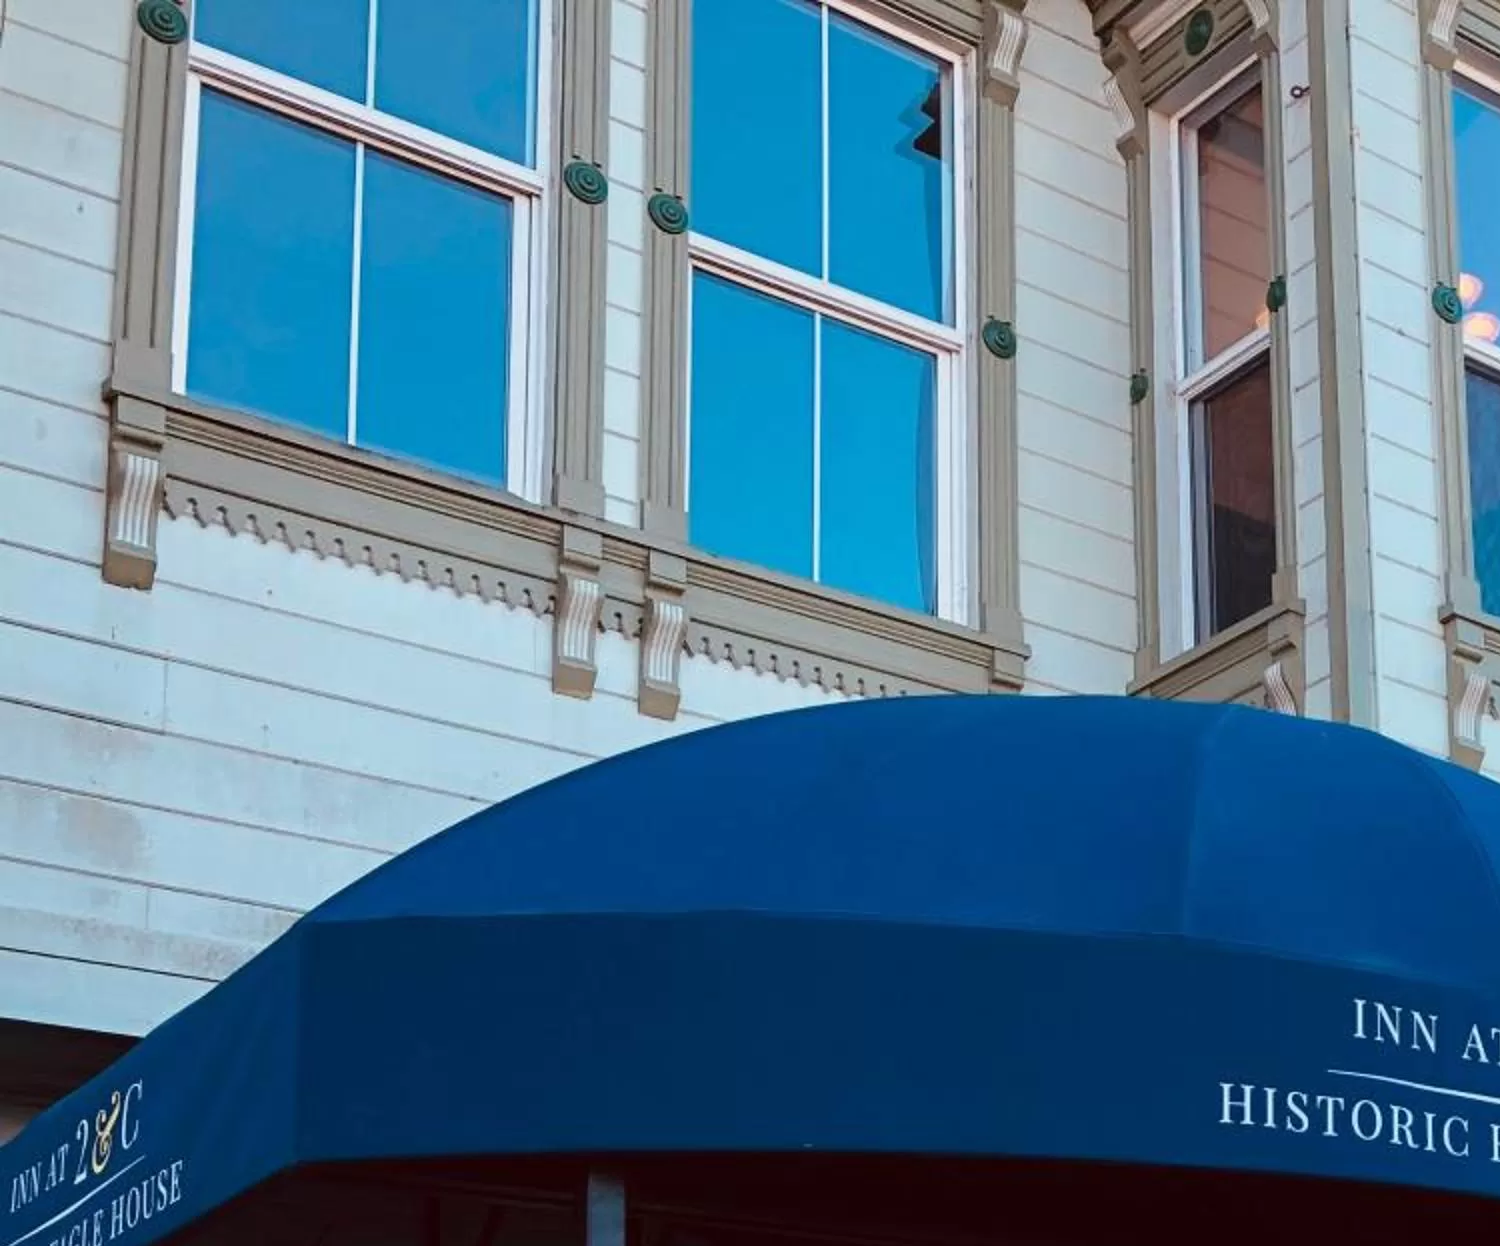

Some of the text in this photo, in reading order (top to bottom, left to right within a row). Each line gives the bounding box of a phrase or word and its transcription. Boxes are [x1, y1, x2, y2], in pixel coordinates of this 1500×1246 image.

[1353, 998, 1438, 1053] INN
[1218, 1081, 1471, 1157] HISTORIC
[10, 1160, 42, 1213] INN
[45, 1142, 69, 1191] AT
[109, 1159, 184, 1241] HOUSE
